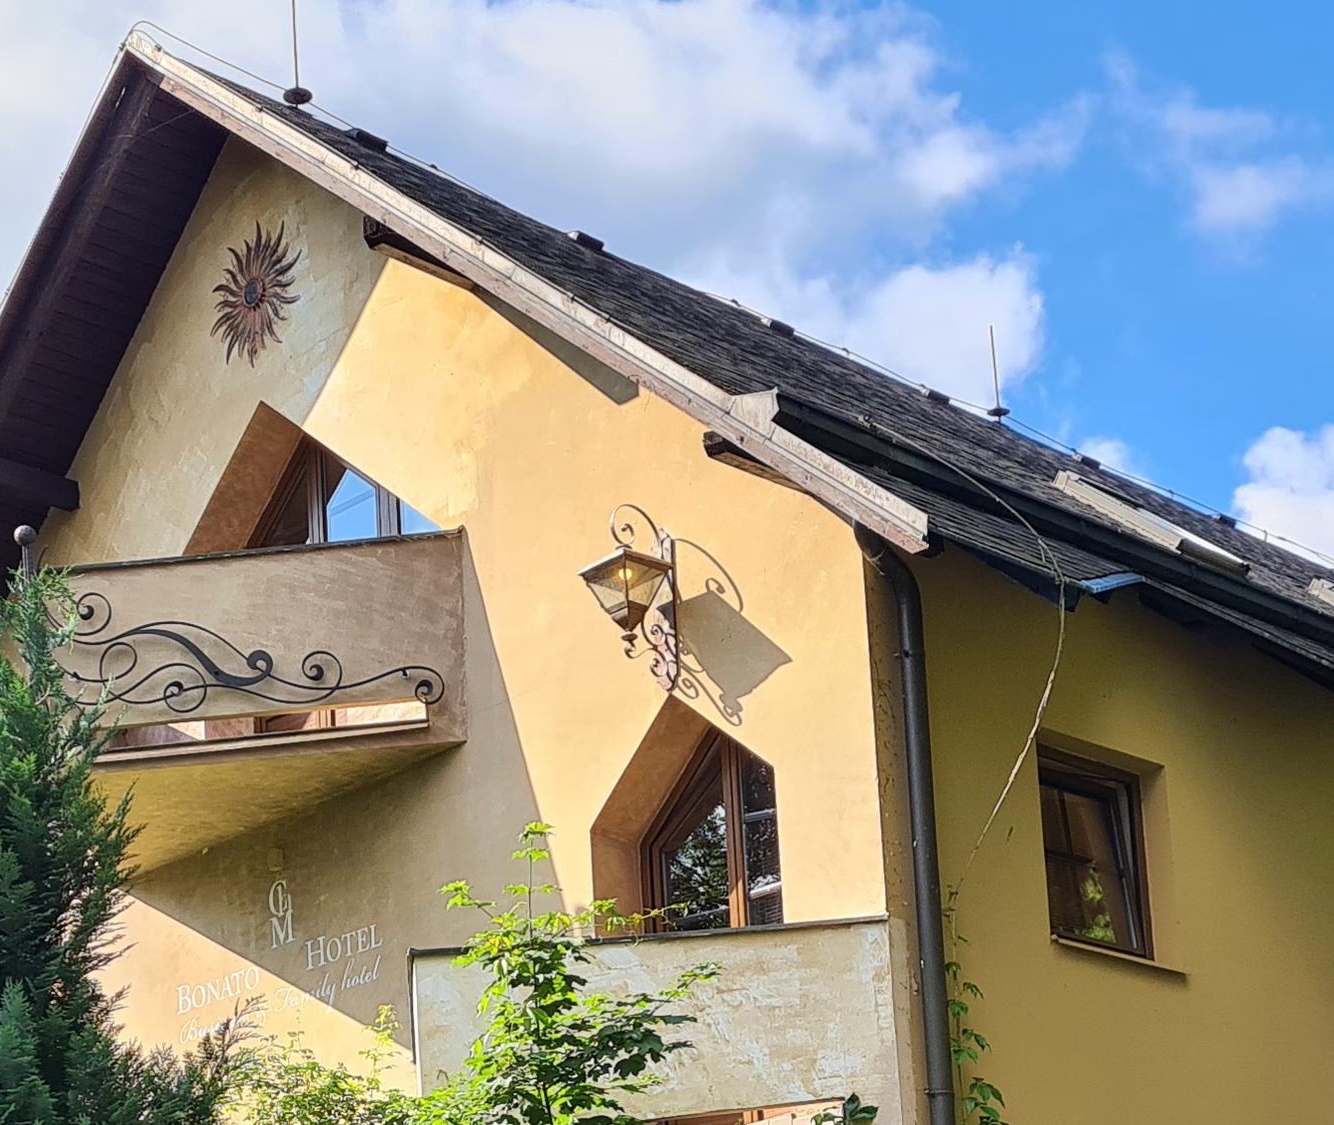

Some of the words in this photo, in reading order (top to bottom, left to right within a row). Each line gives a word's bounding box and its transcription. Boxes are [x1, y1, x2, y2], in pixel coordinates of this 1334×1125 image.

[176, 966, 260, 1015] BONATO
[305, 923, 383, 971] HOTEL
[341, 954, 381, 991] hotel
